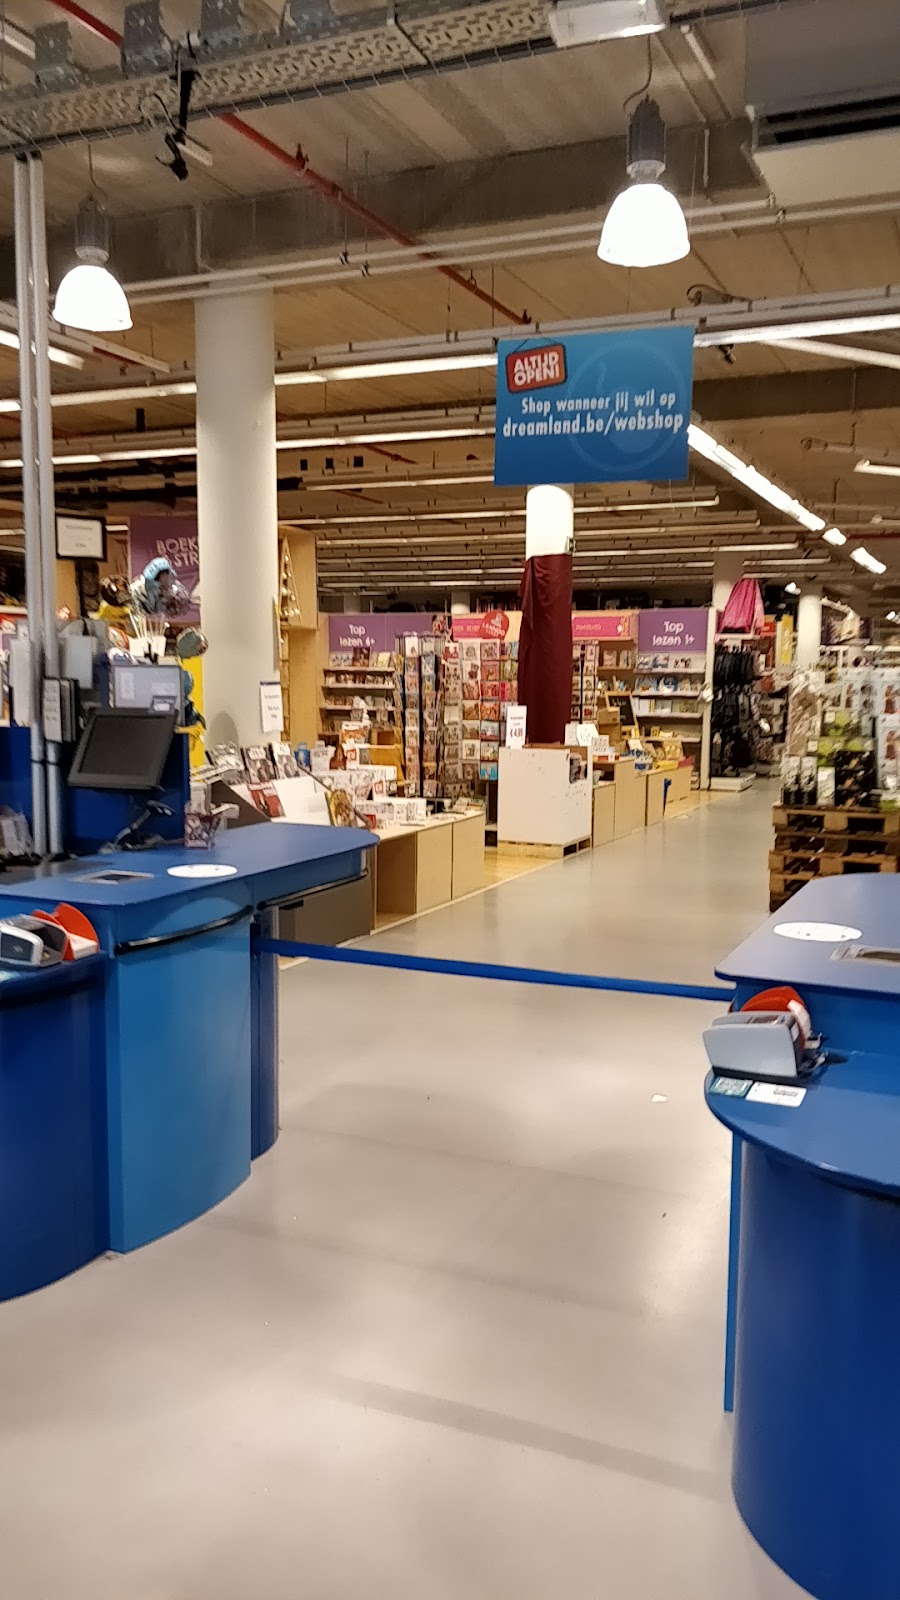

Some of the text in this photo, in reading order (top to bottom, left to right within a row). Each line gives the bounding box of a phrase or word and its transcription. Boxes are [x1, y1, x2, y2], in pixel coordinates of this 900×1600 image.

[513, 351, 559, 373] ALTIJD
[513, 364, 560, 386] OPEN!
[521, 388, 676, 417] Shop wanneer jij wil op
[502, 408, 684, 438] dreamland.be/webshop
[349, 624, 366, 637] Top
[663, 620, 684, 634] Top
[339, 637, 363, 648] lezen
[652, 634, 681, 646] lezen
